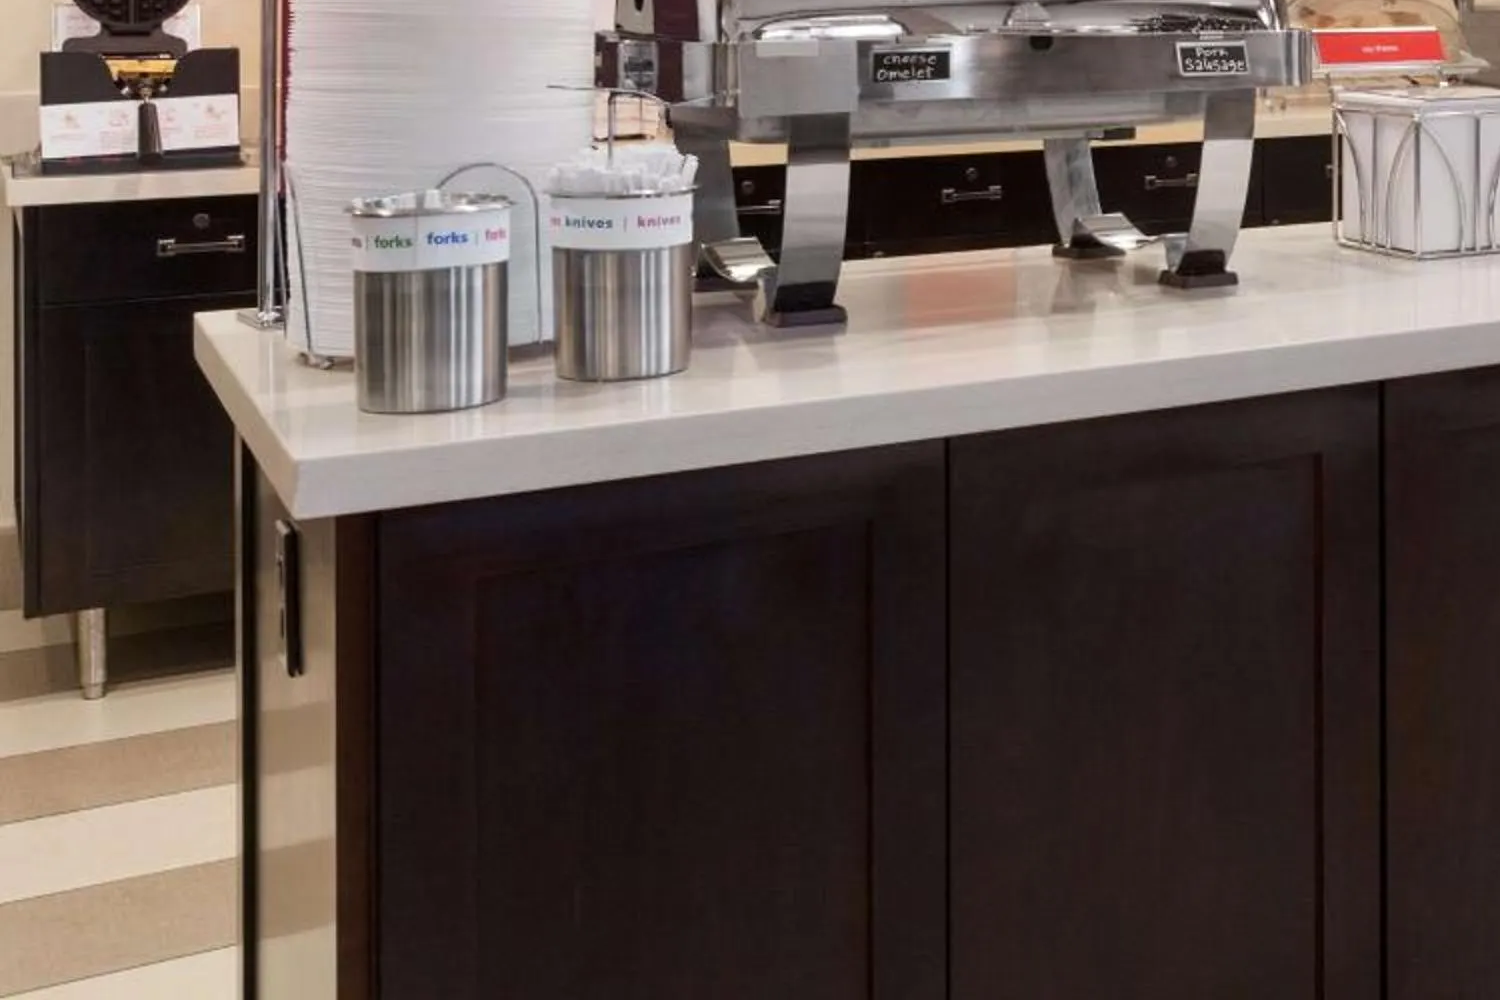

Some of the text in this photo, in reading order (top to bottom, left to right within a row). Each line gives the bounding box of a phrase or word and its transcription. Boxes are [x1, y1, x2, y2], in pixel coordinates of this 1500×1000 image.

[565, 215, 613, 229] knives
[374, 235, 413, 249] forks
[427, 231, 469, 245] forks
